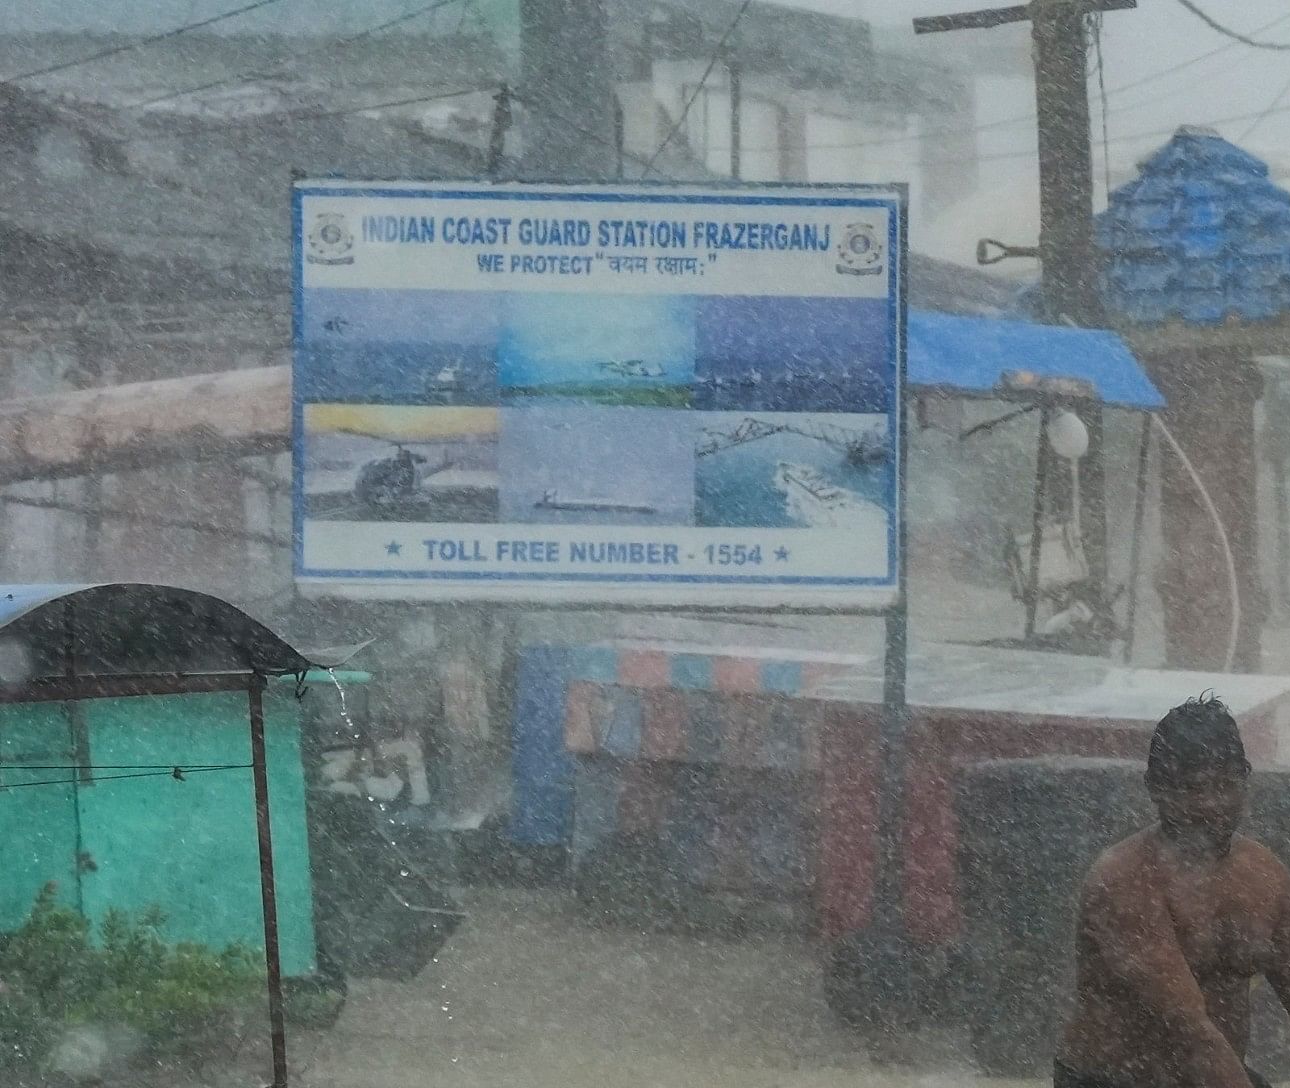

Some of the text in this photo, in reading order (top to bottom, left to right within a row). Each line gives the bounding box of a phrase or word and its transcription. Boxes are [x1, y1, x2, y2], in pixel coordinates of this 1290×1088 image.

[361, 215, 831, 251] INDIAN COAST GUARD STATION FRAZERGANJ
[477, 254, 504, 272] WE
[510, 255, 593, 275] PROTECT
[423, 539, 488, 562] TOLL
[496, 540, 560, 563] FREE
[570, 541, 679, 565] NUMBER
[704, 544, 763, 566] 1554
